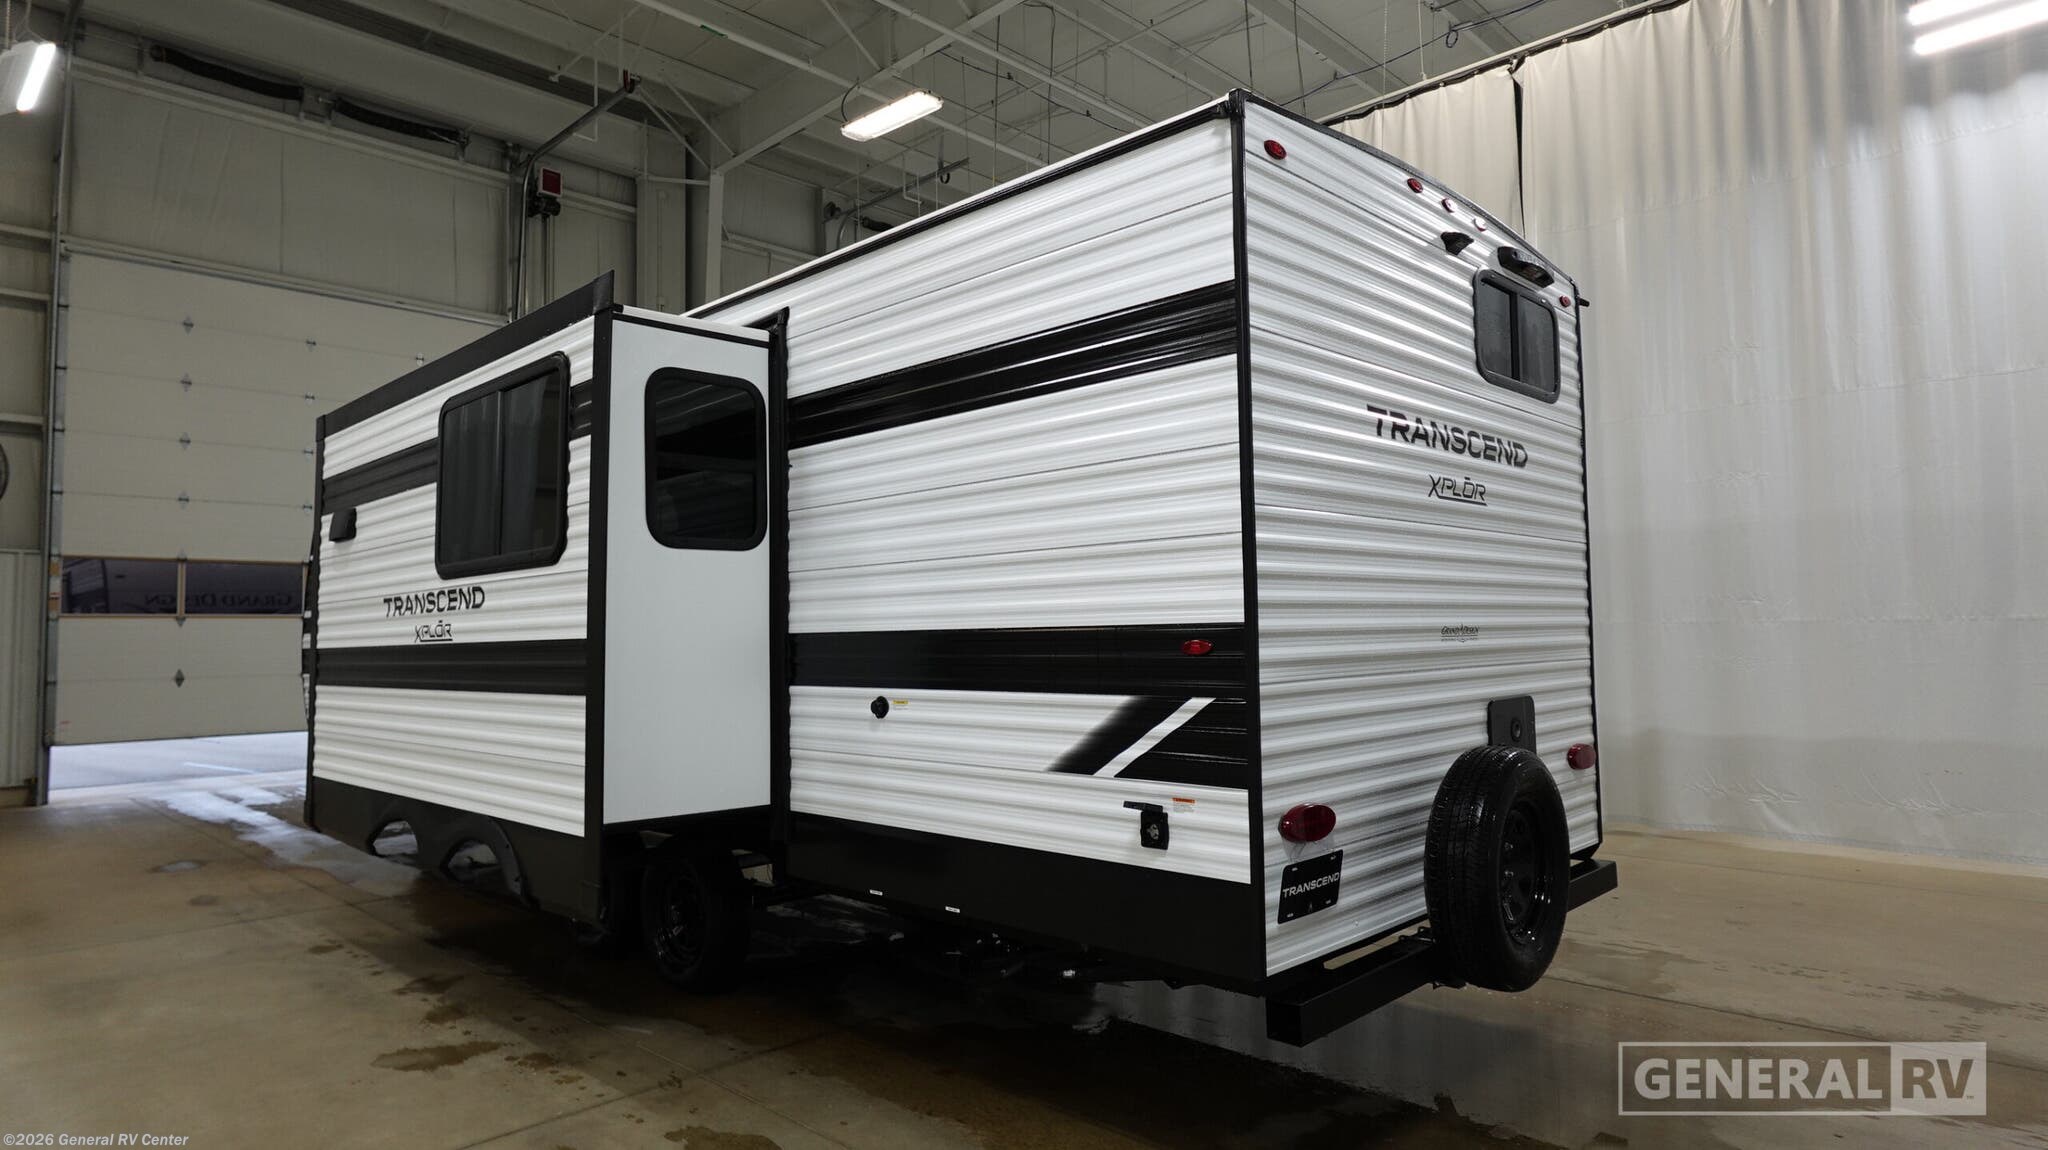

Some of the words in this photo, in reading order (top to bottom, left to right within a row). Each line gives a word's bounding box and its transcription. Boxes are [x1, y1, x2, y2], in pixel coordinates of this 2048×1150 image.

[1366, 404, 1529, 468] TRANSCEND
[383, 586, 485, 617] TRANSCEND
[1282, 872, 1340, 898] TRANSCEND
